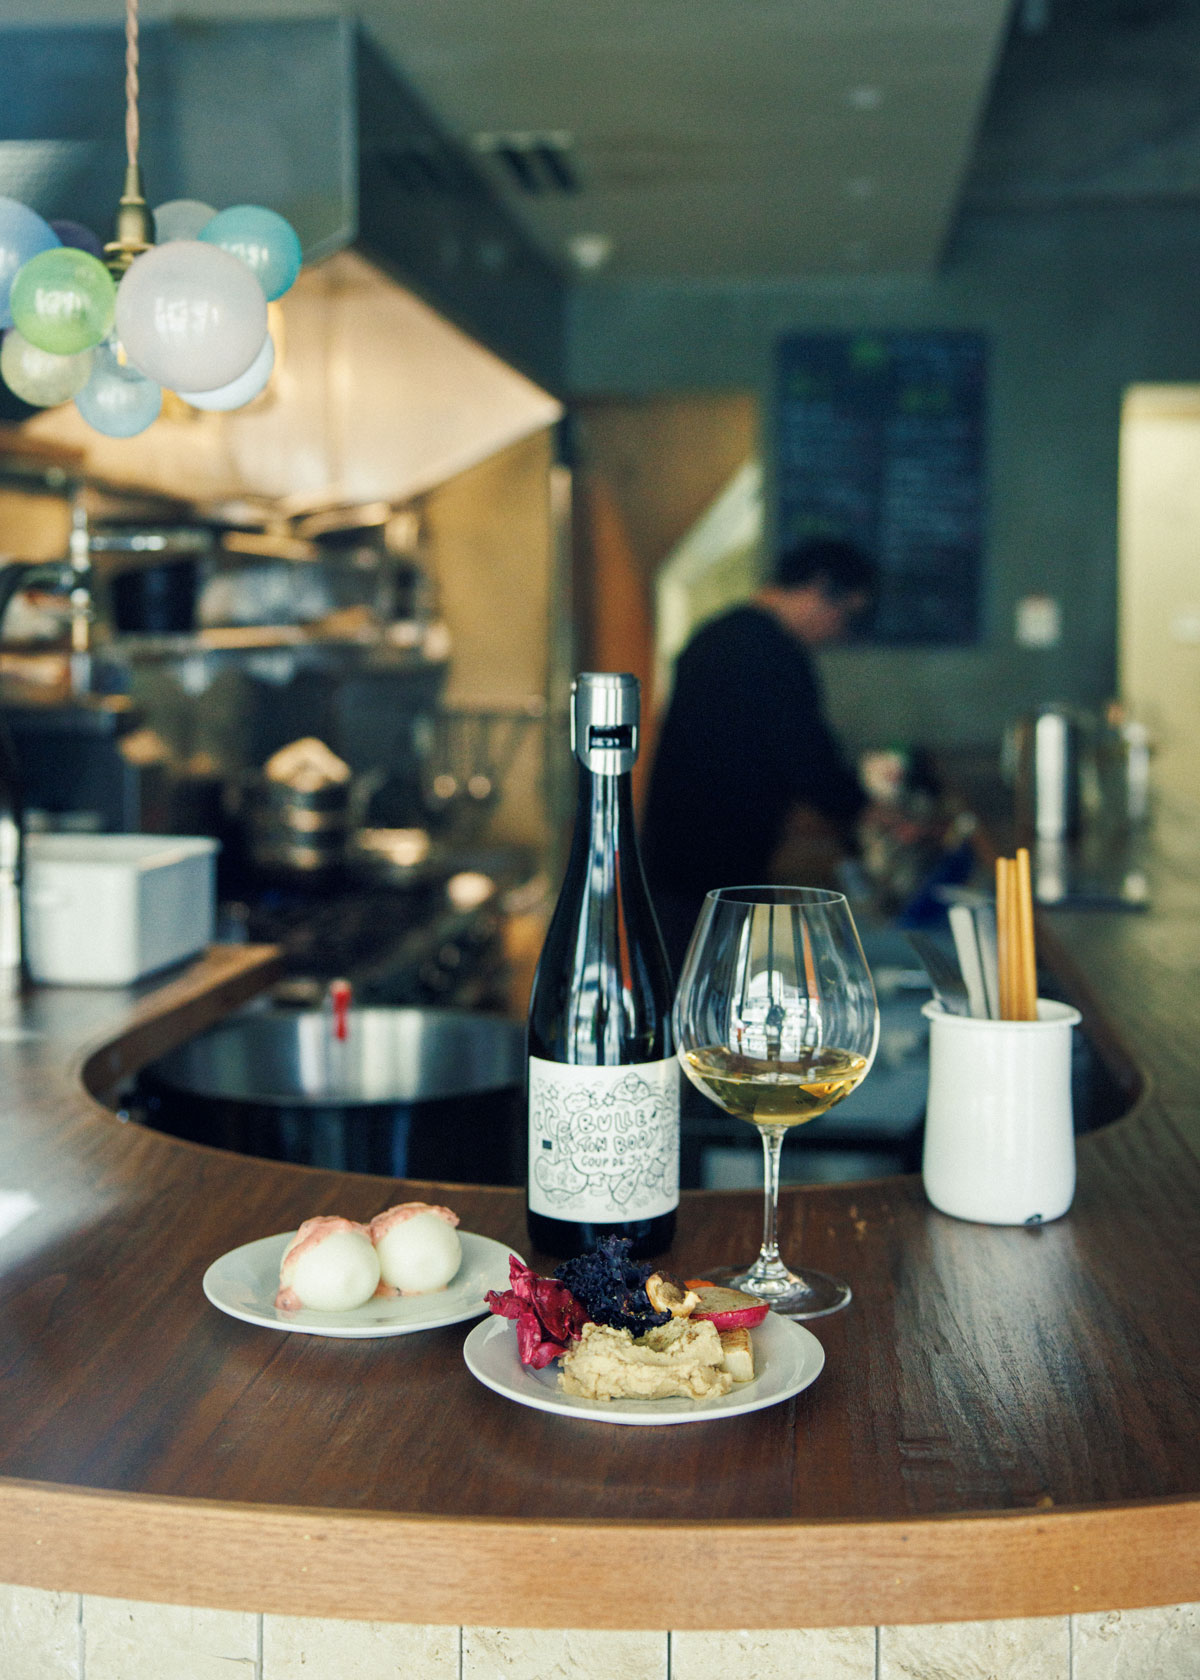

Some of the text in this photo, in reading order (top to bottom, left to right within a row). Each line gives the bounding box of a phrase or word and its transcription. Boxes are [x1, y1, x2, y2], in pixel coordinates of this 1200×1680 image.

[577, 1109, 647, 1134] BULLE
[577, 1135, 607, 1152] TON
[581, 1155, 609, 1167] COUP
